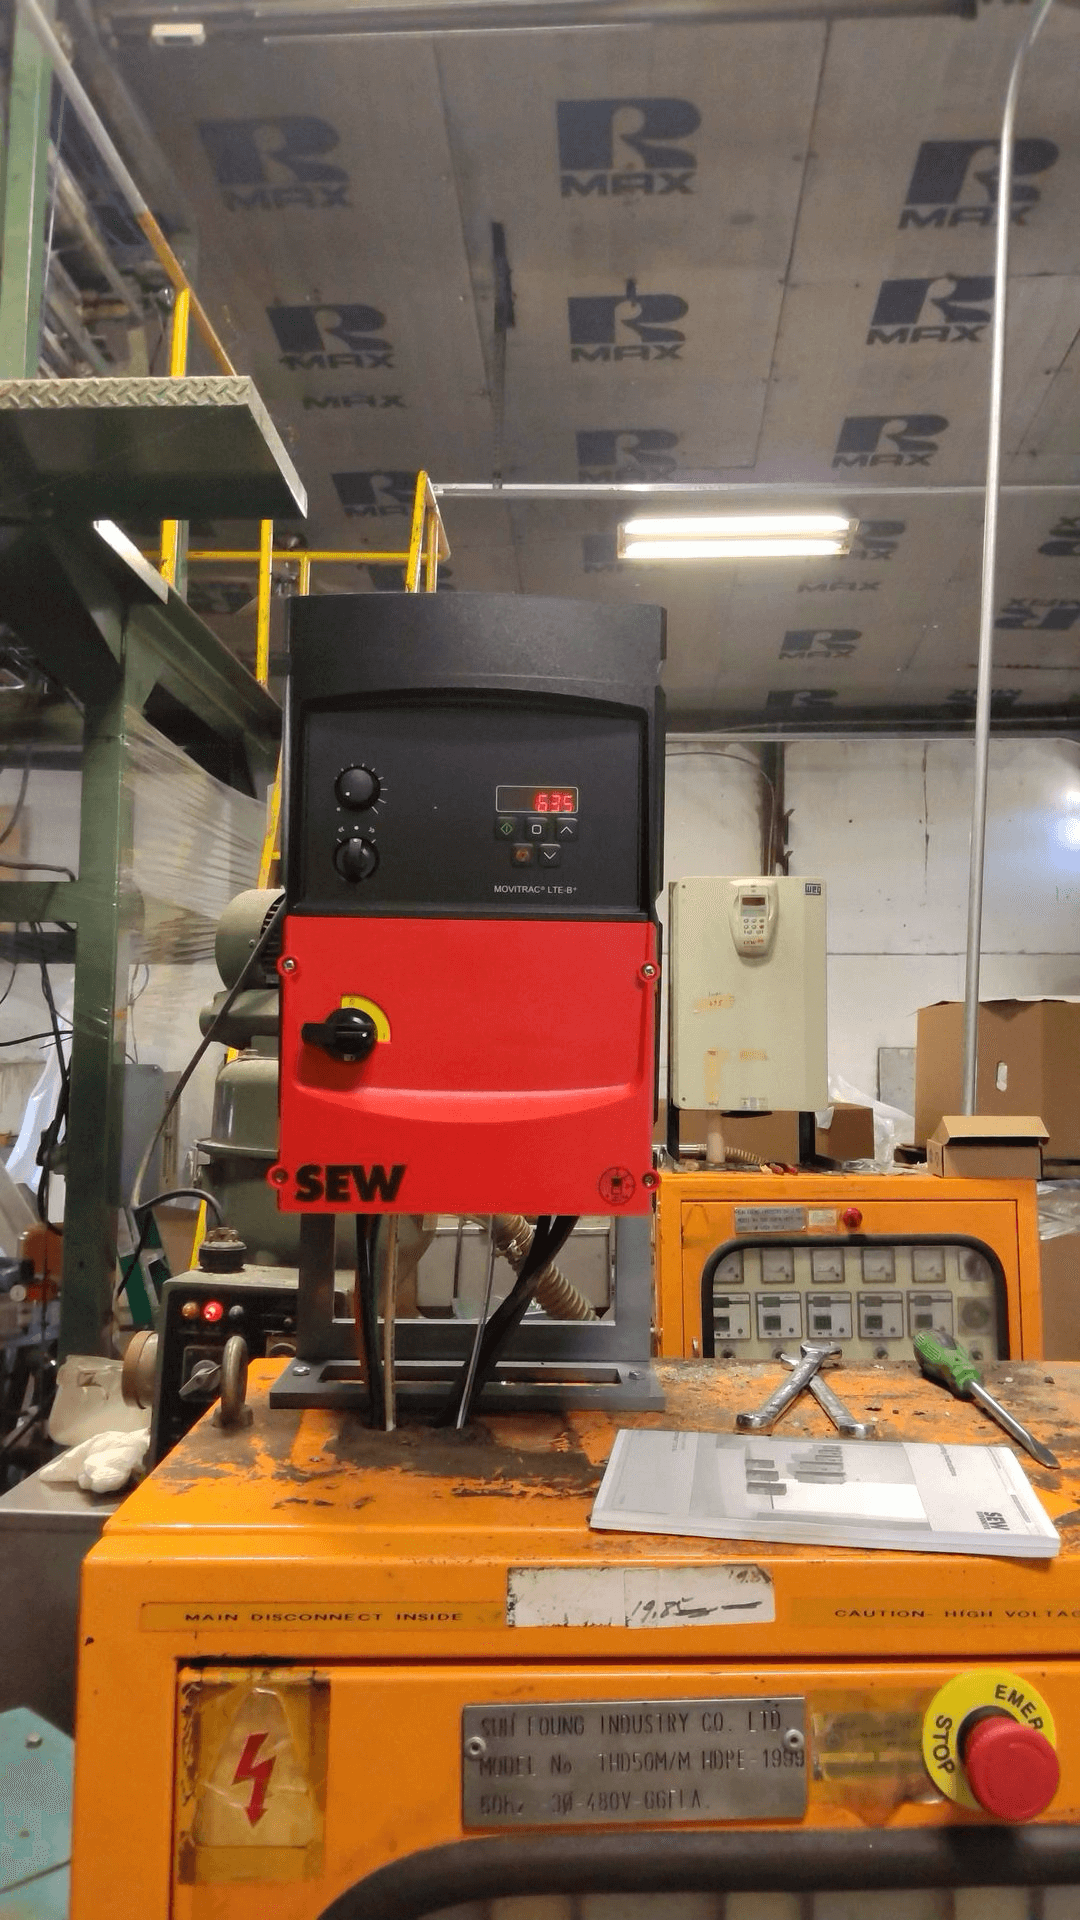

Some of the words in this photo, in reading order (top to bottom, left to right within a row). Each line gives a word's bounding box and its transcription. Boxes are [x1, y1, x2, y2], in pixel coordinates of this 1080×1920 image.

[560, 171, 697, 198] MAX
[221, 186, 353, 212] MAX
[866, 326, 988, 345] MAX
[278, 352, 396, 371] MAX
[570, 344, 686, 363] MAX
[302, 394, 408, 410] MAX
[830, 452, 936, 469] MAX
[342, 505, 410, 517] MA
[797, 581, 881, 593] MAX
[778, 650, 855, 660] MAX
[537, 794, 573, 812] 635
[295, 1164, 407, 1202] SEW
[185, 1613, 239, 1621] MAIN
[250, 1613, 383, 1621] DISCONNECT
[396, 1612, 463, 1621] INSIDE
[944, 1610, 993, 1618] HIGH
[600, 1711, 689, 1735] INDUSTRY
[702, 1711, 732, 1731] CO.
[932, 1714, 955, 1774] STOP
[479, 1755, 537, 1777] MODEL
